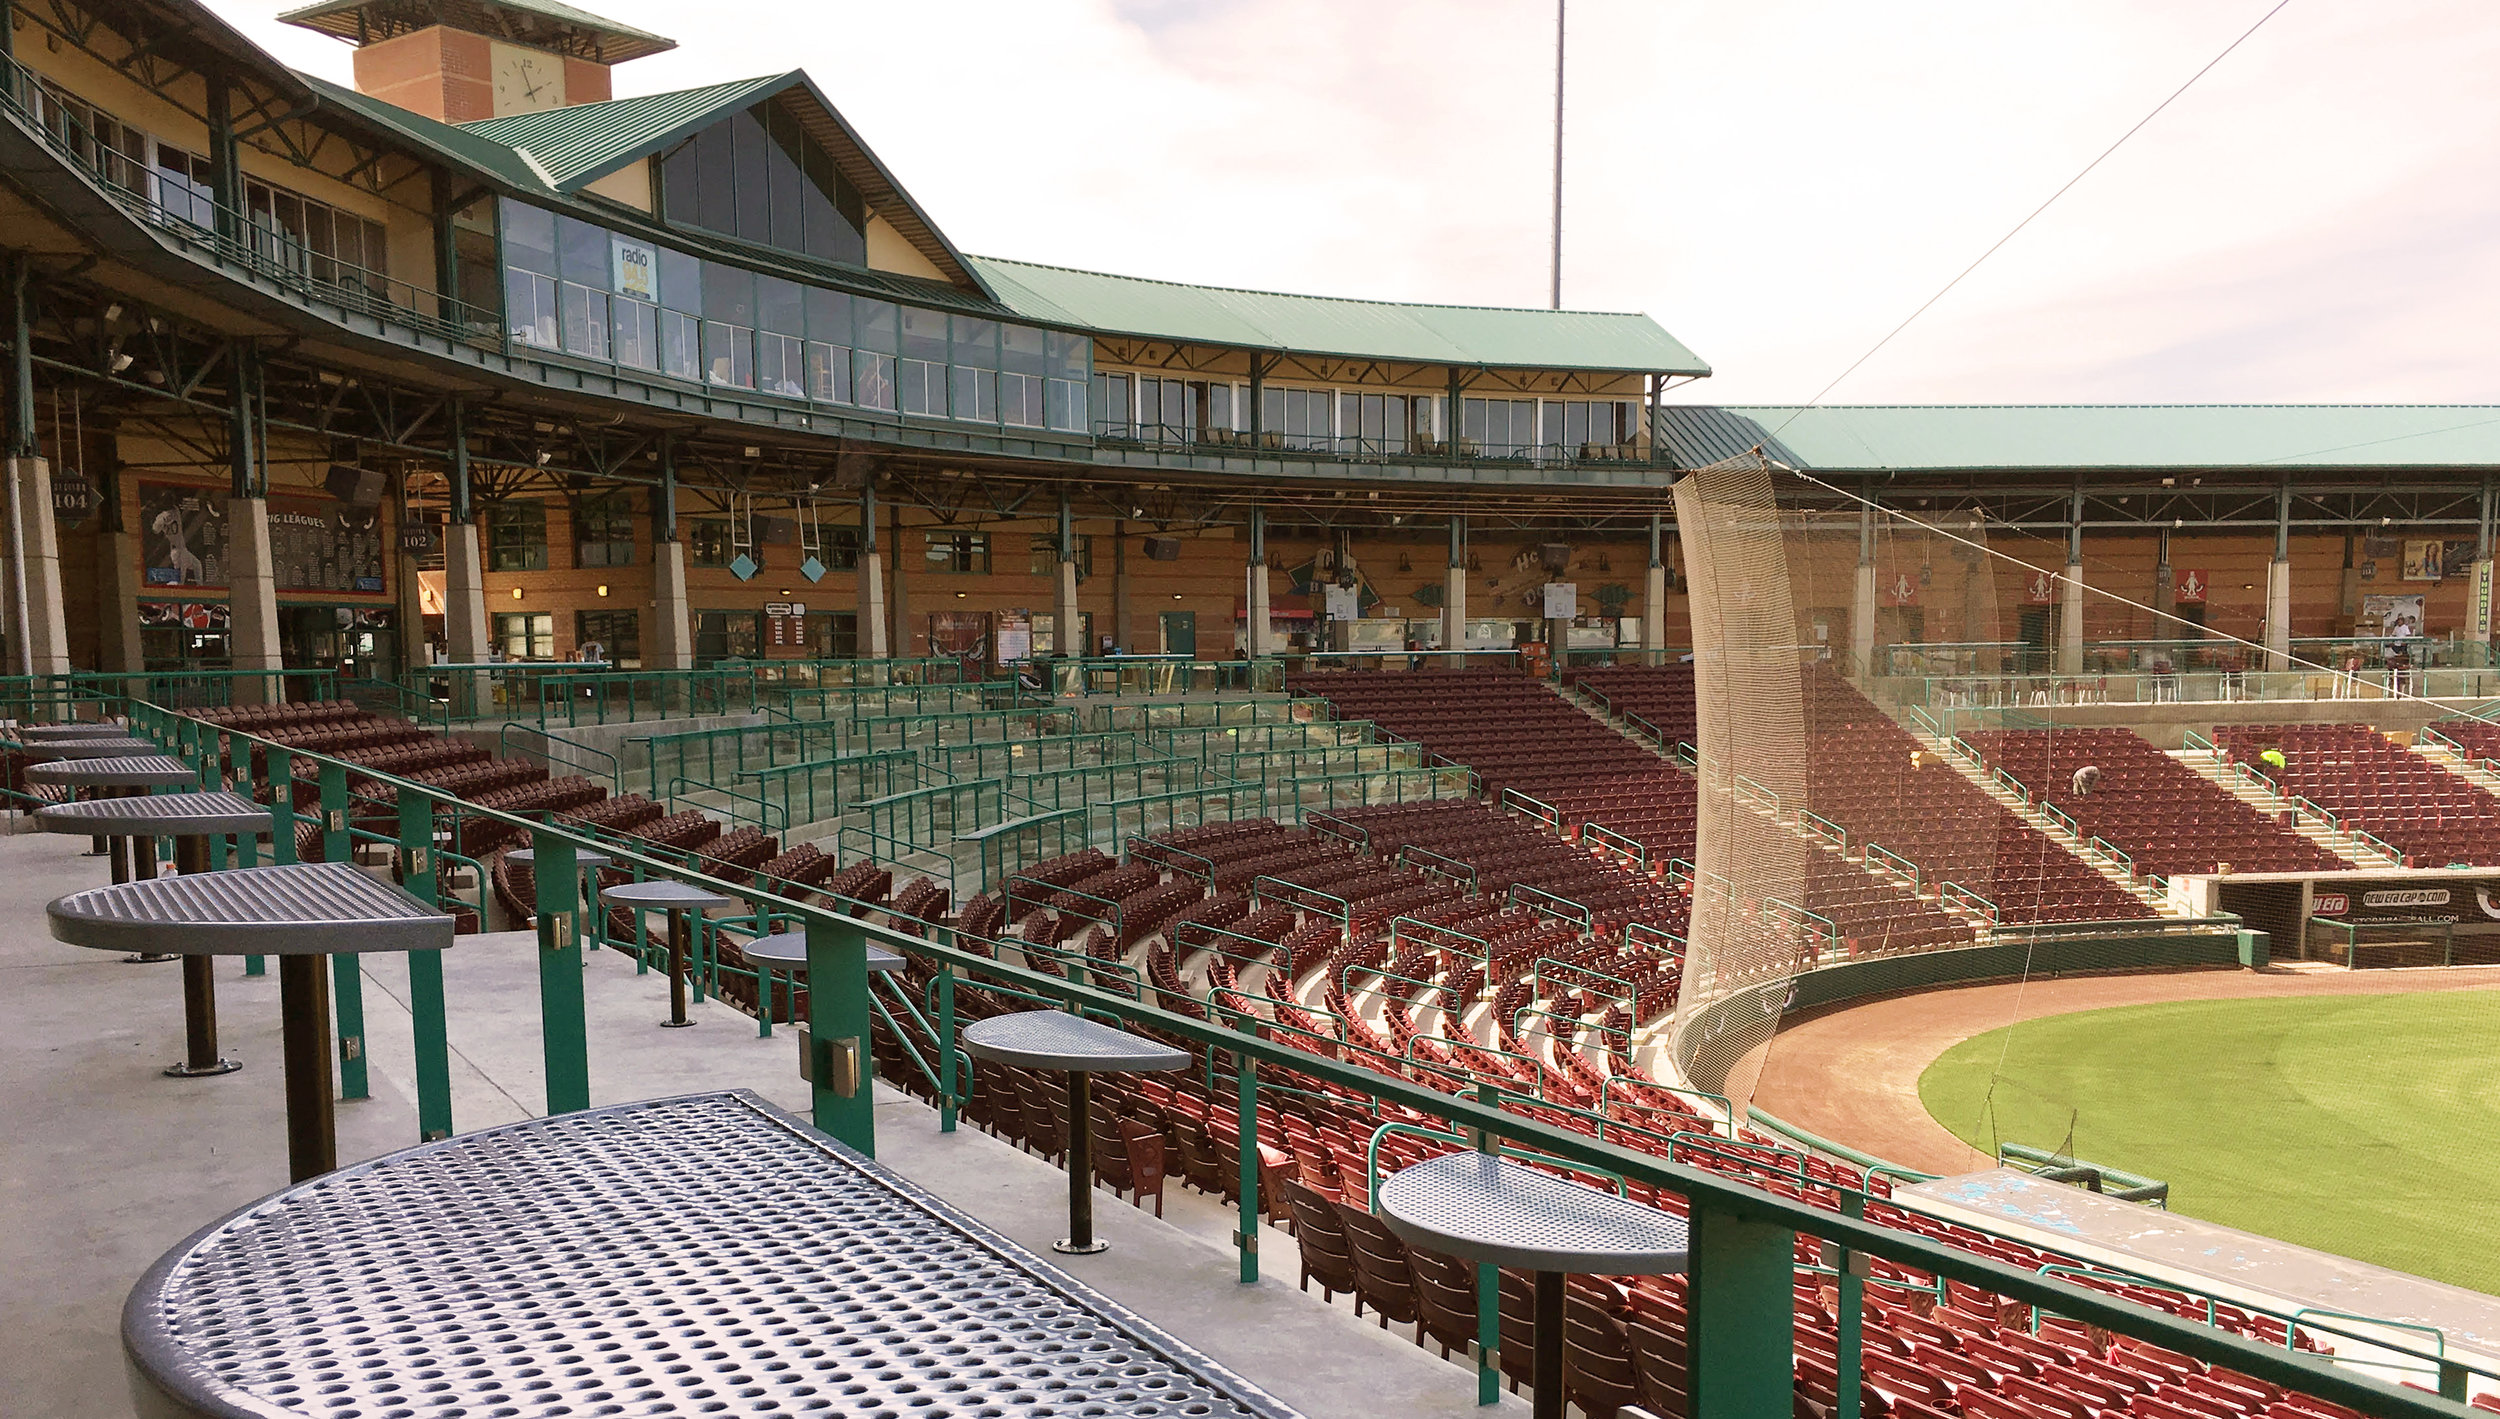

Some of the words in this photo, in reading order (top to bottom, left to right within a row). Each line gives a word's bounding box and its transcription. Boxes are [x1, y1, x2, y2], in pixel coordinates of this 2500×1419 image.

[522, 58, 533, 68] 12
[622, 248, 648, 267] radio
[55, 494, 87, 509] 104
[283, 514, 325, 529] LEAGUES
[404, 536, 427, 548] 102
